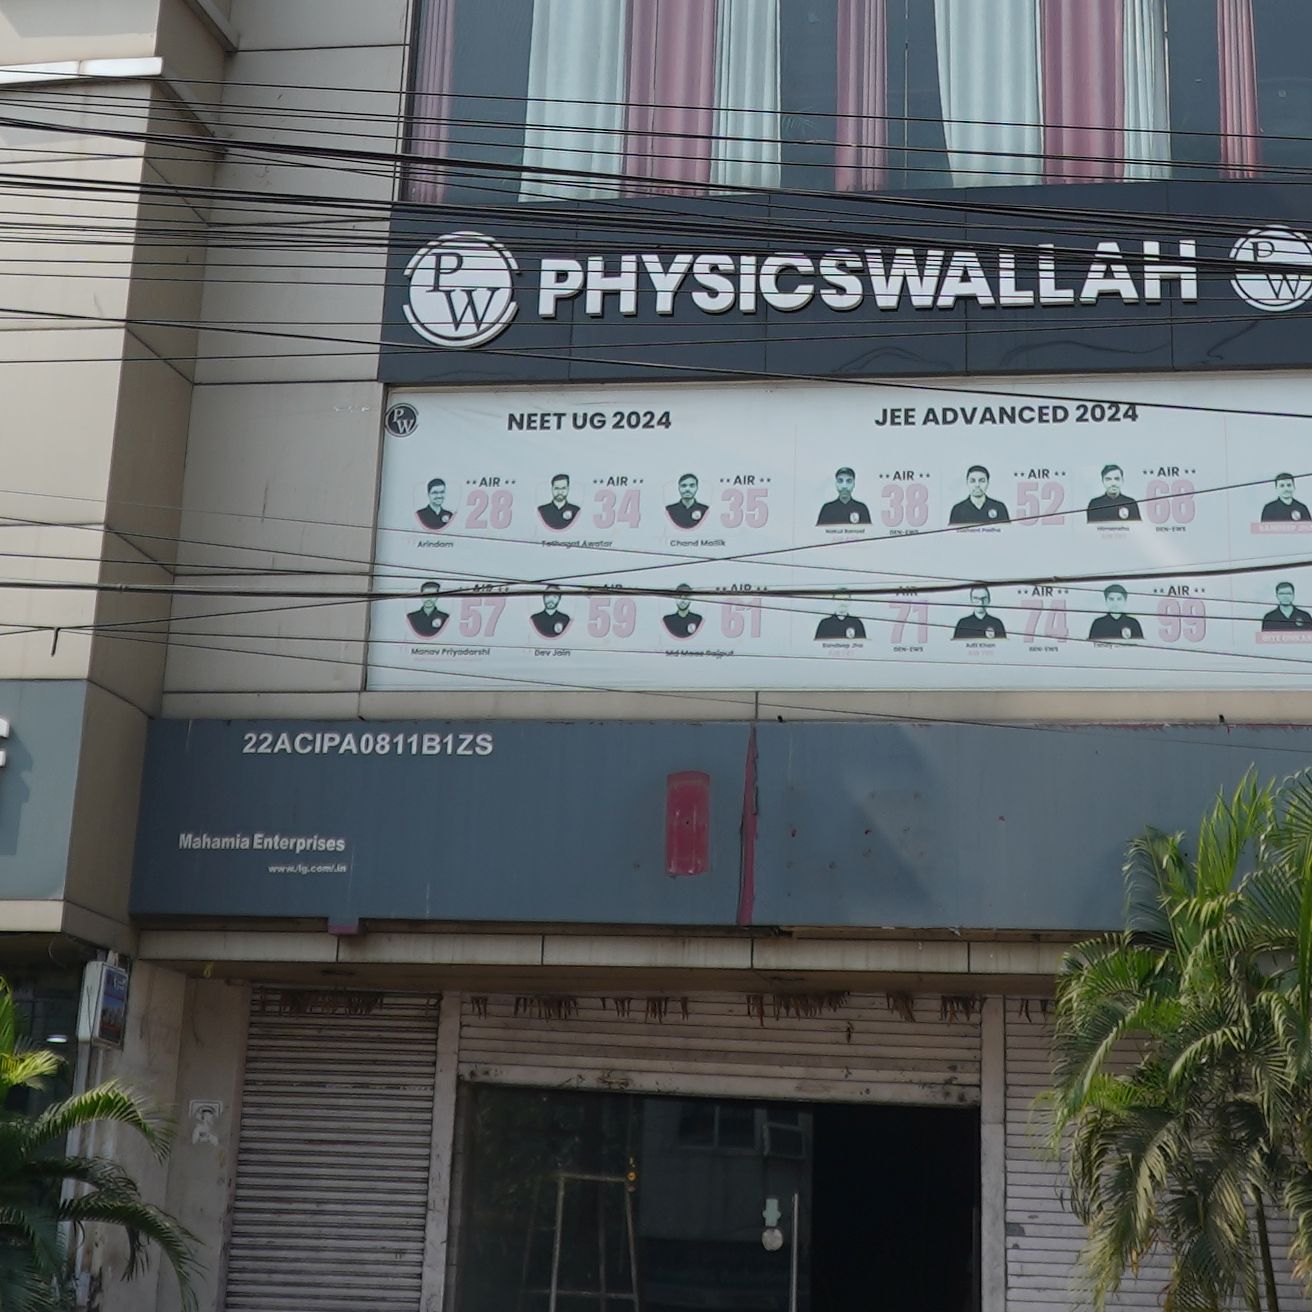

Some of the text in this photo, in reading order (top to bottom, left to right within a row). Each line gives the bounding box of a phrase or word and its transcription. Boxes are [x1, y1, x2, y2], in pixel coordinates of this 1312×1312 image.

[538, 239, 1199, 318] PHYSICSWALLAH
[507, 411, 672, 431] NEET UG 2024
[875, 404, 1138, 426] JEE ADVANCED 2024
[479, 477, 500, 487] AIR
[606, 476, 629, 487] AIR
[733, 475, 756, 485] AIR
[893, 471, 914, 480] AIR
[1028, 469, 1050, 479] AIR
[1157, 467, 1179, 477] AIR
[465, 490, 513, 529] 28
[592, 489, 641, 529] 34
[720, 488, 769, 529] 35
[881, 484, 928, 527] 38
[1016, 482, 1064, 526] 52
[1146, 479, 1195, 524] 68
[1032, 585, 1054, 597] AIR
[1168, 585, 1190, 596] AIR
[459, 598, 507, 638] 57
[588, 598, 636, 638] 59
[720, 598, 762, 638] 61
[888, 599, 928, 644] 71
[1021, 599, 1069, 643] 74
[1158, 598, 1206, 643] 99
[242, 733, 493, 756] 22ACIPA0811B1ZS
[178, 833, 346, 854] Mahamia Enterprises
